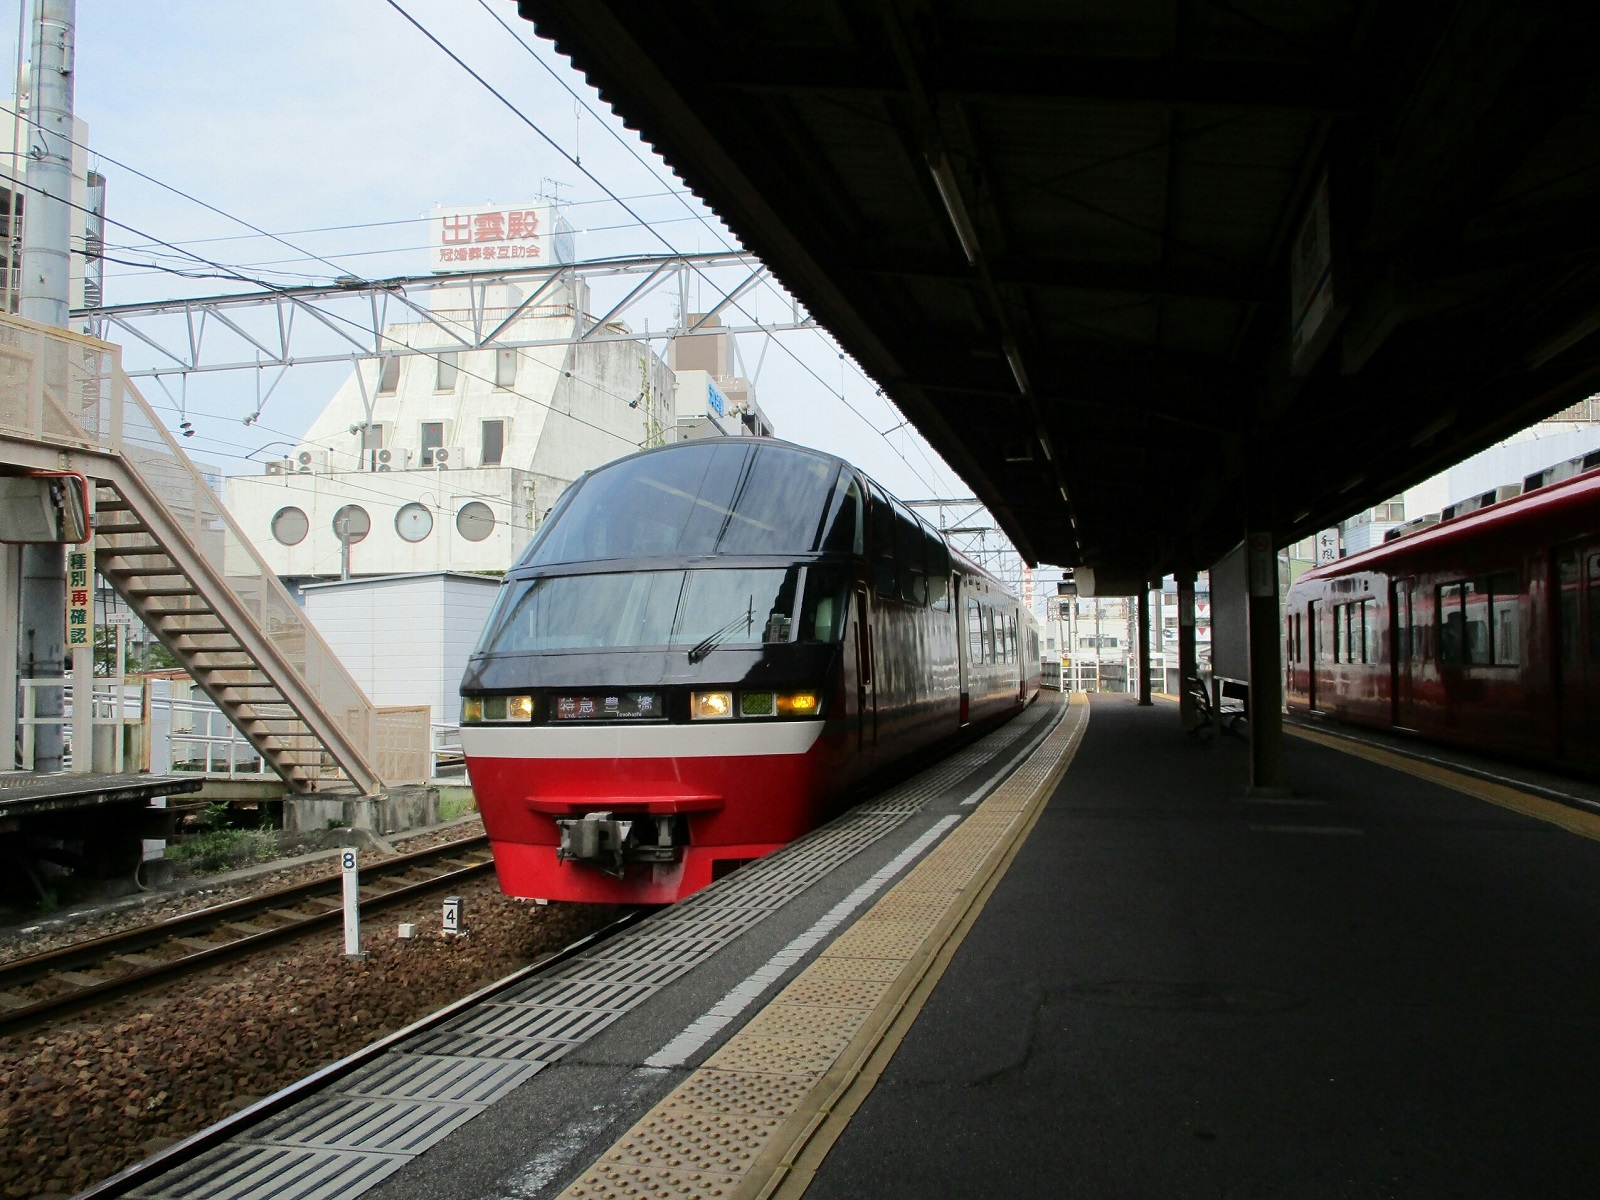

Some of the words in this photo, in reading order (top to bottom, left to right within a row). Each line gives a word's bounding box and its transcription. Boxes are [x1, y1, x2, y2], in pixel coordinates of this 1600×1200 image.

[441, 211, 540, 245] 出雲殿
[439, 244, 541, 262] 冠婚葬祭互助会
[70, 553, 88, 644] 種別再確認
[560, 697, 594, 713] 特急
[604, 695, 653, 713] 豊橋
[342, 852, 356, 869] 8
[446, 908, 456, 925] 4
